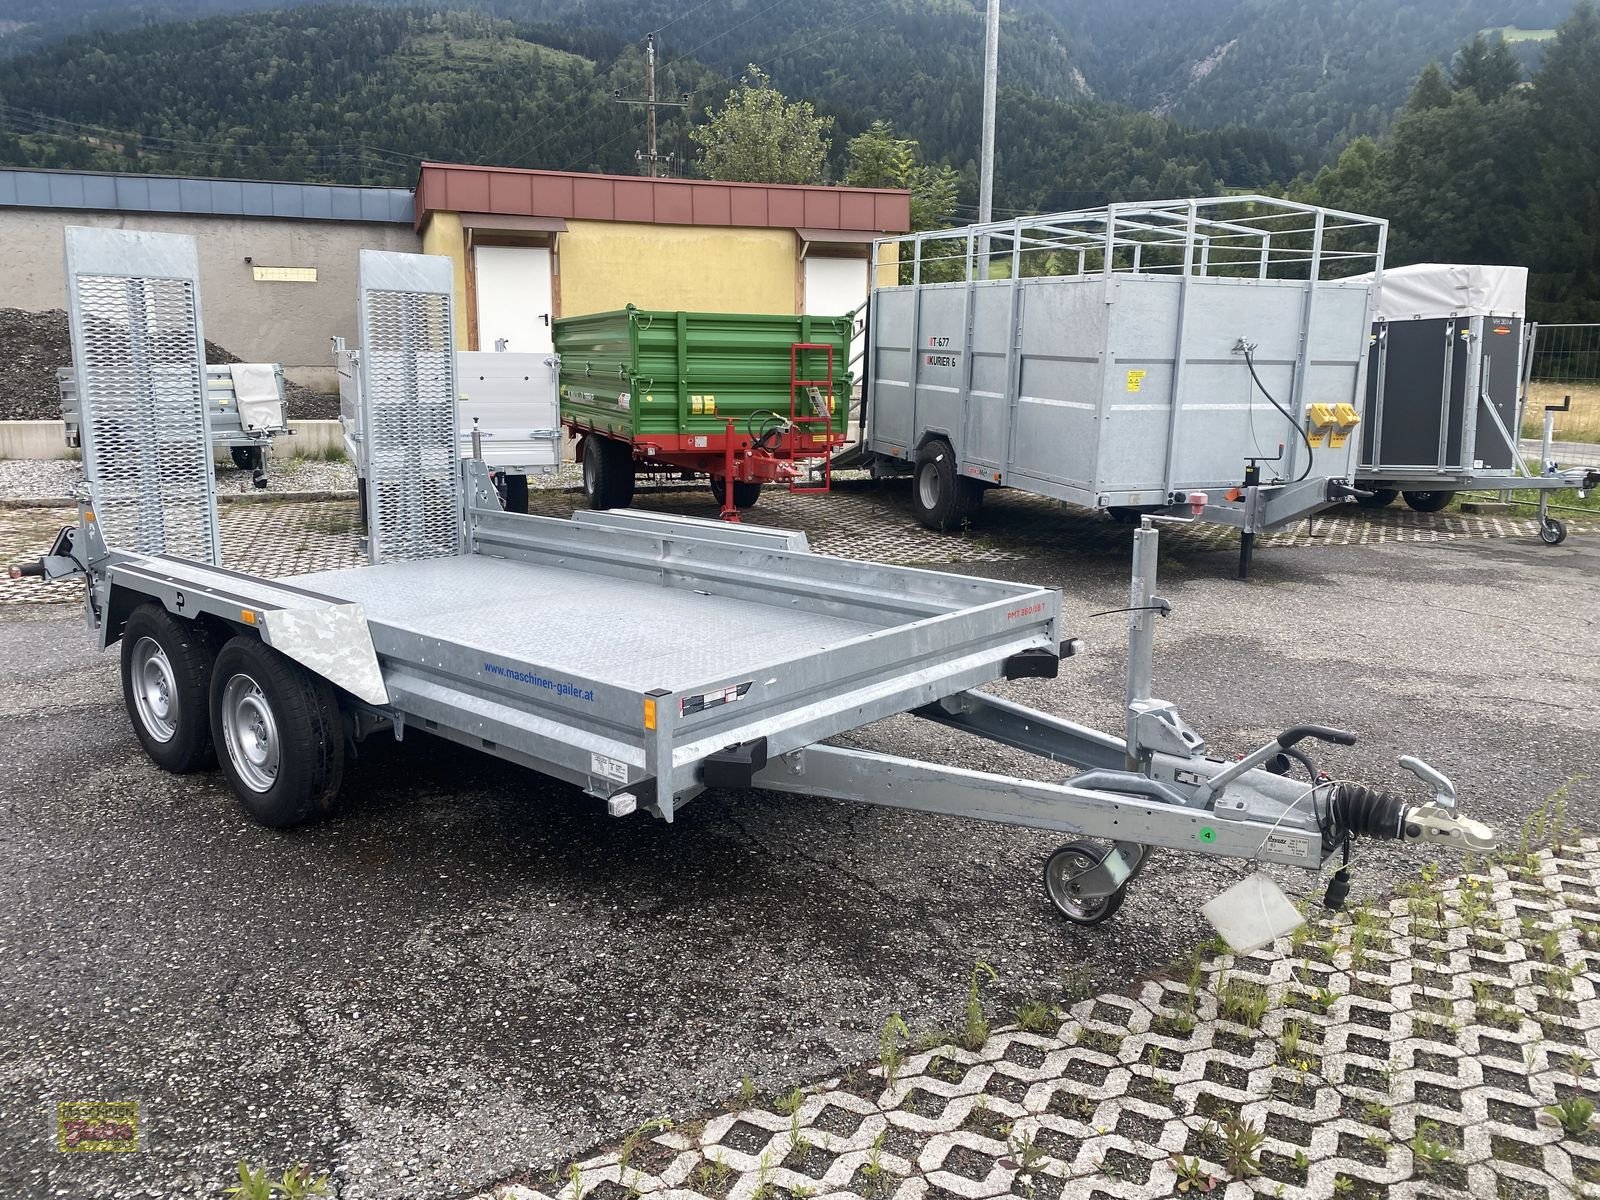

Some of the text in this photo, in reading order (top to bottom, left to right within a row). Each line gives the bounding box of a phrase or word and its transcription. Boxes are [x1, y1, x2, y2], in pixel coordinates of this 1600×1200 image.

[951, 357, 956, 367] 6
[1007, 609, 1020, 620] PMT
[484, 662, 594, 702] www.maschinen-gailer.at
